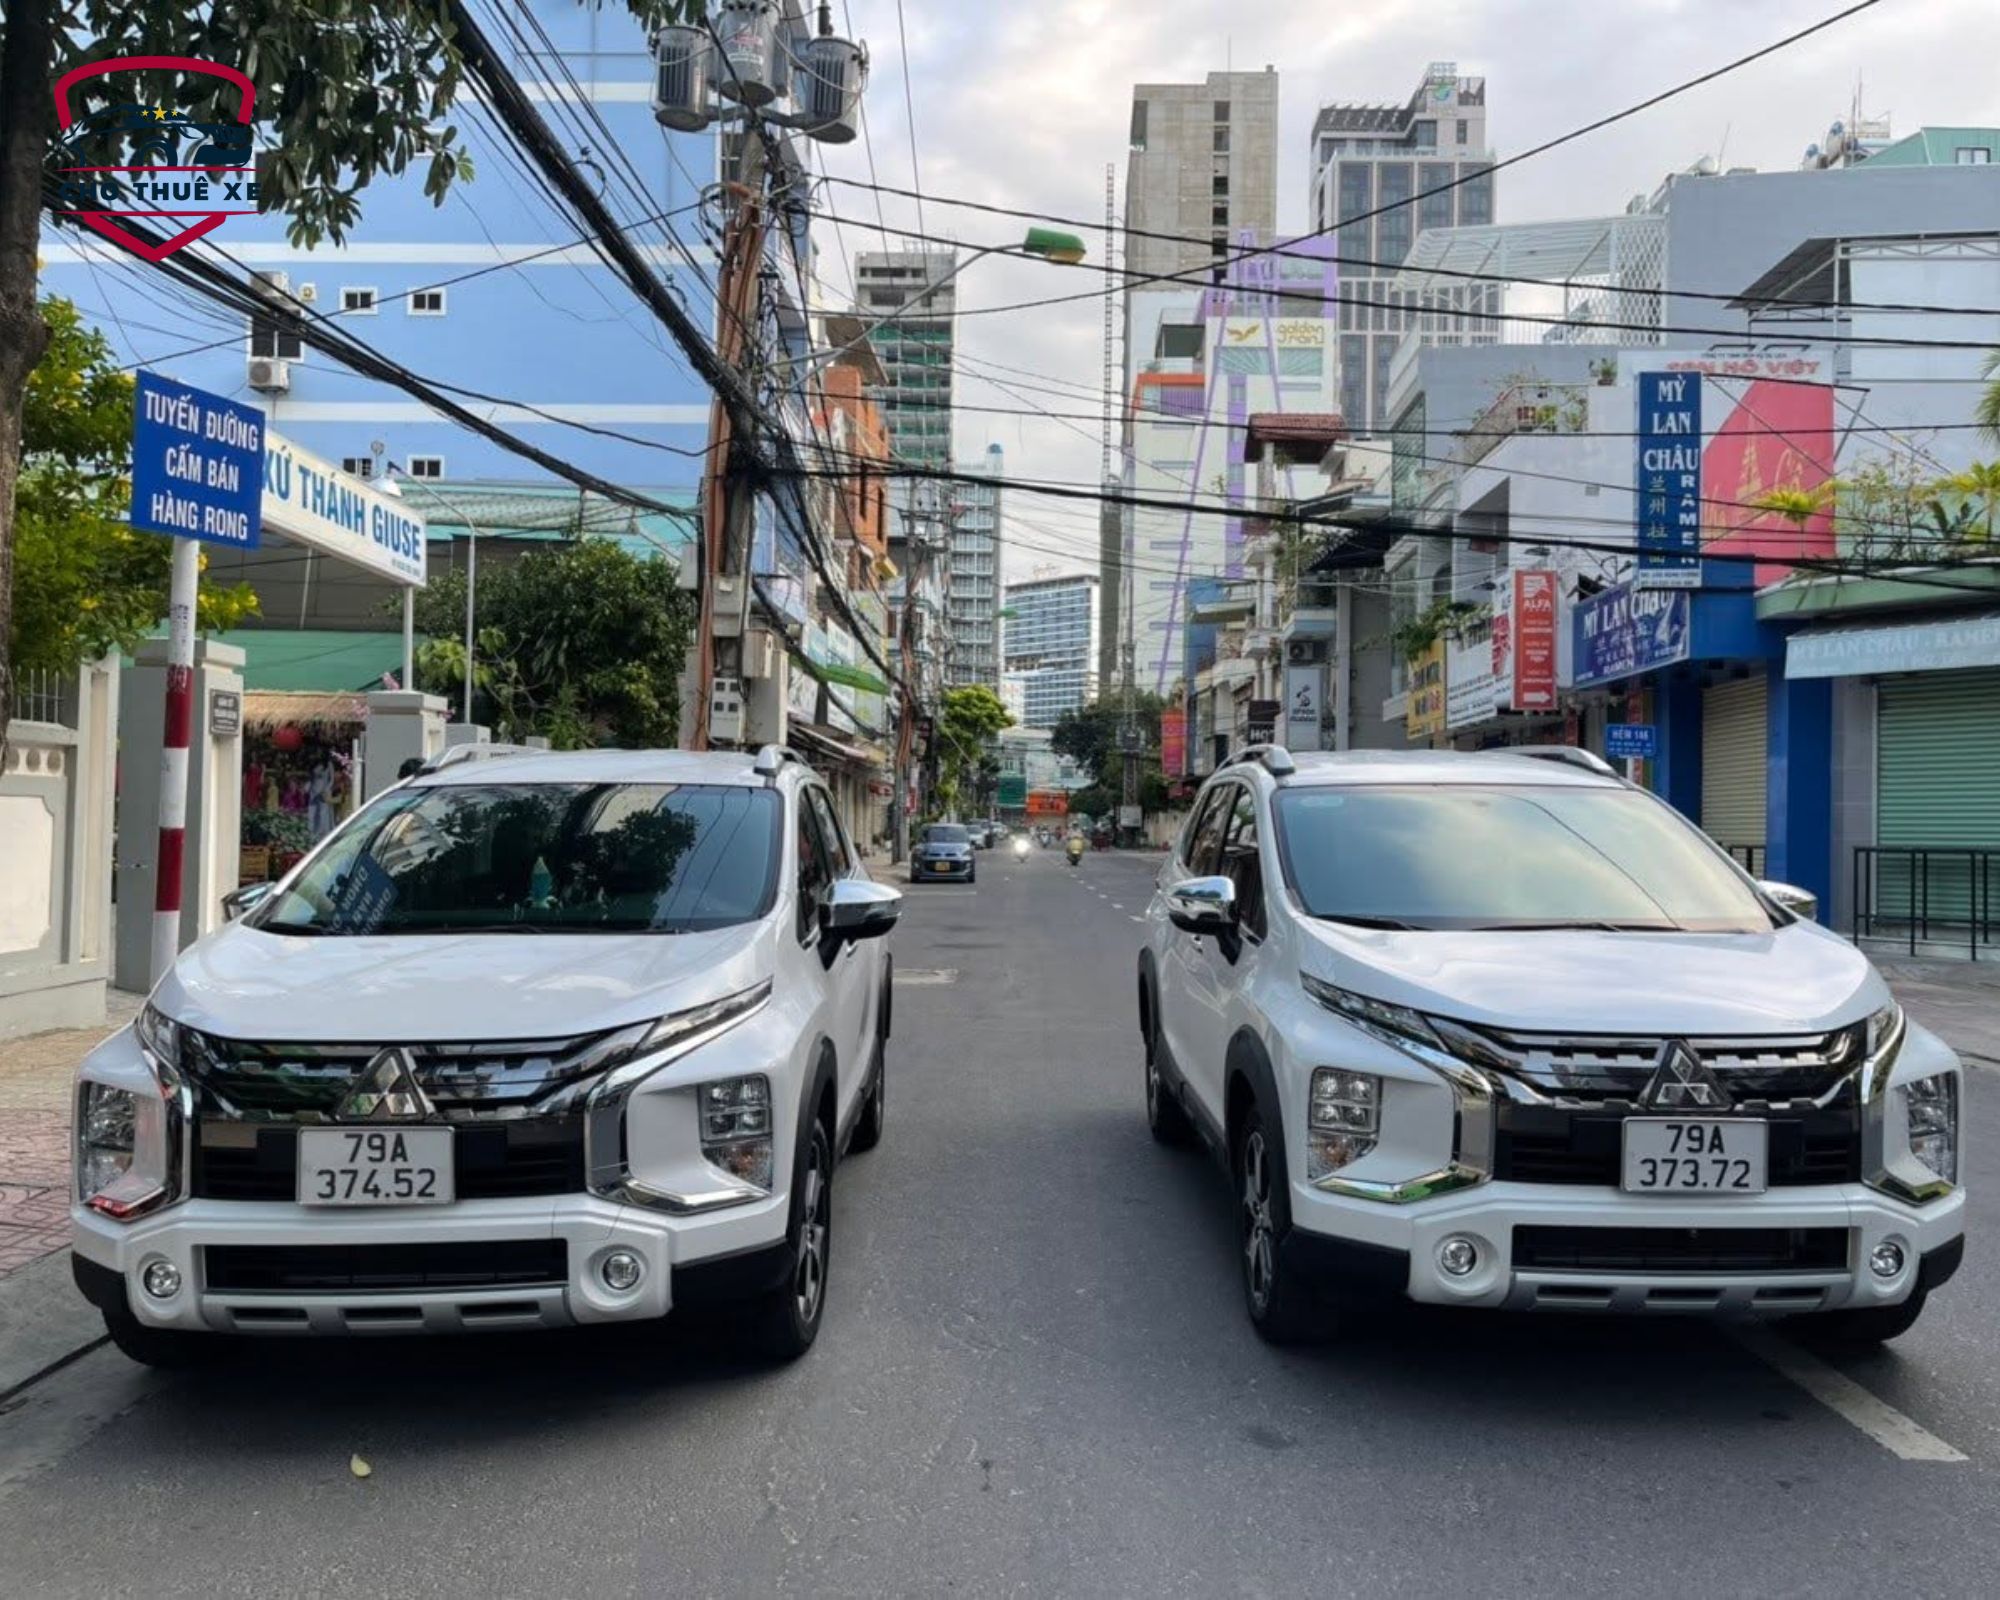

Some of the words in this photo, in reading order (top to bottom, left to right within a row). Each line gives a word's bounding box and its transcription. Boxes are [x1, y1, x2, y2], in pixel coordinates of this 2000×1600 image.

[1766, 359, 1820, 374] VIỆT
[1658, 374, 1687, 402] MỲ
[144, 390, 199, 434] TUYẾN
[205, 409, 259, 452] ĐƯỜNG
[1653, 412, 1691, 435] LAN
[165, 443, 203, 483] CẤM
[207, 456, 239, 492] BÁN
[1643, 444, 1699, 471] CHÂU
[151, 490, 198, 530] HÀNG
[204, 505, 248, 540] RONG
[298, 466, 366, 536] THÁNH
[372, 504, 421, 563] GIUSE
[1603, 596, 1629, 631] LAN
[344, 1133, 408, 1163] 79A
[1666, 1124, 1725, 1154] 79A
[316, 1168, 436, 1199] 374.52
[1639, 1158, 1750, 1188] 373.72
